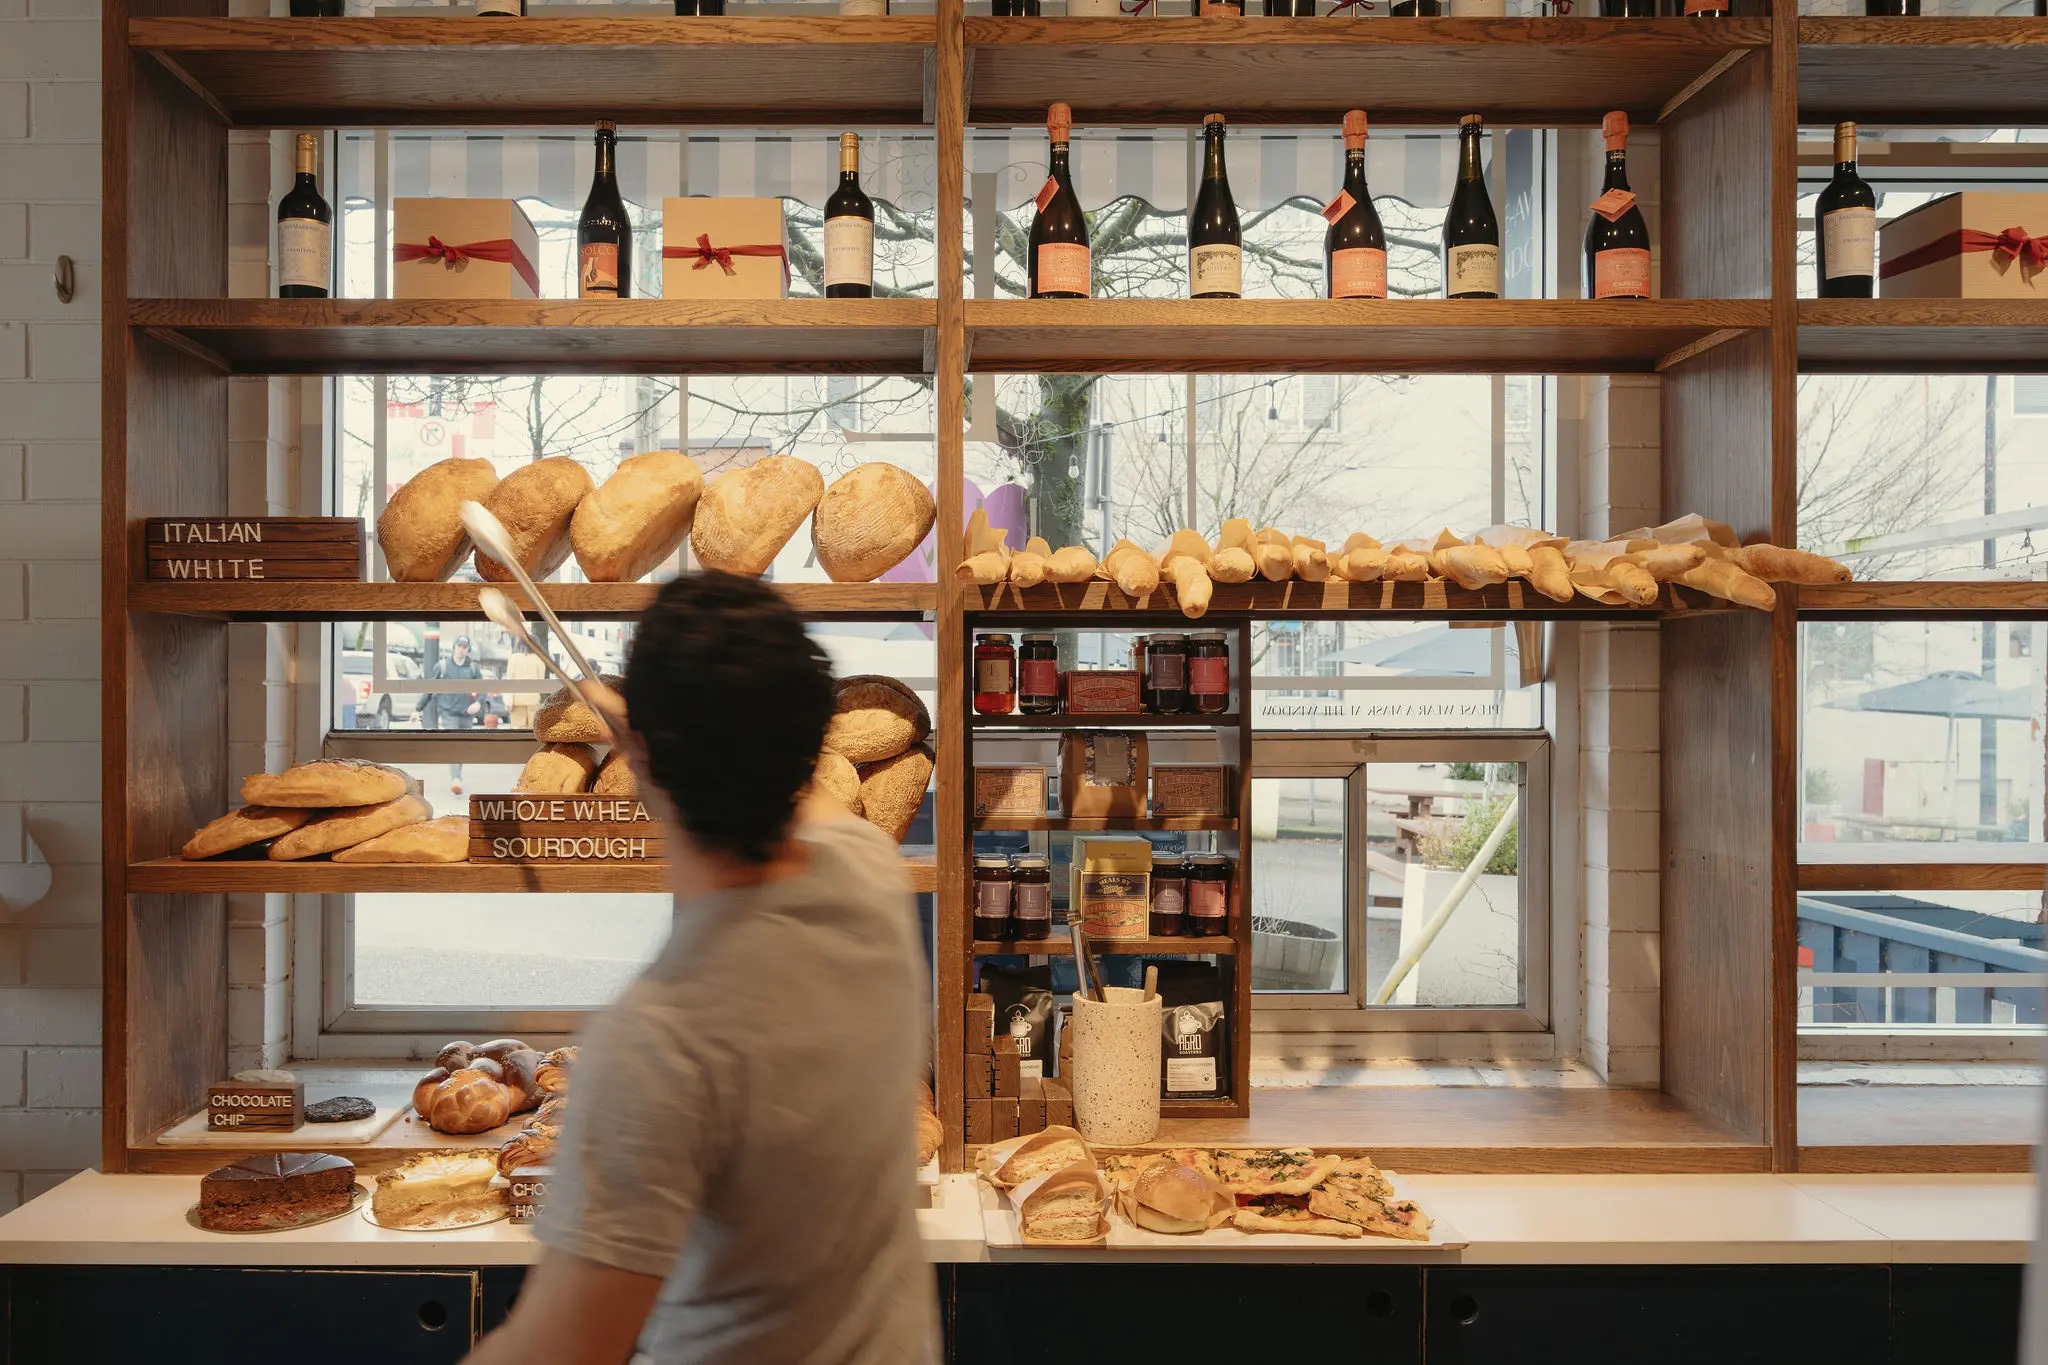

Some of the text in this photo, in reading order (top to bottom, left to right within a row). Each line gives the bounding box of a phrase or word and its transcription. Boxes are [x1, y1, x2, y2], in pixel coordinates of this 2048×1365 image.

[580, 245, 616, 257] SOLCO
[163, 522, 262, 543] ITALIAN
[167, 558, 265, 579] WHITE
[479, 800, 650, 821] WHOLE WHEA
[493, 837, 646, 859] SOURDOUGH
[1178, 1034, 1202, 1051] AGRO
[212, 1095, 292, 1108] CHOCOLATE
[214, 1114, 245, 1126] CHIP
